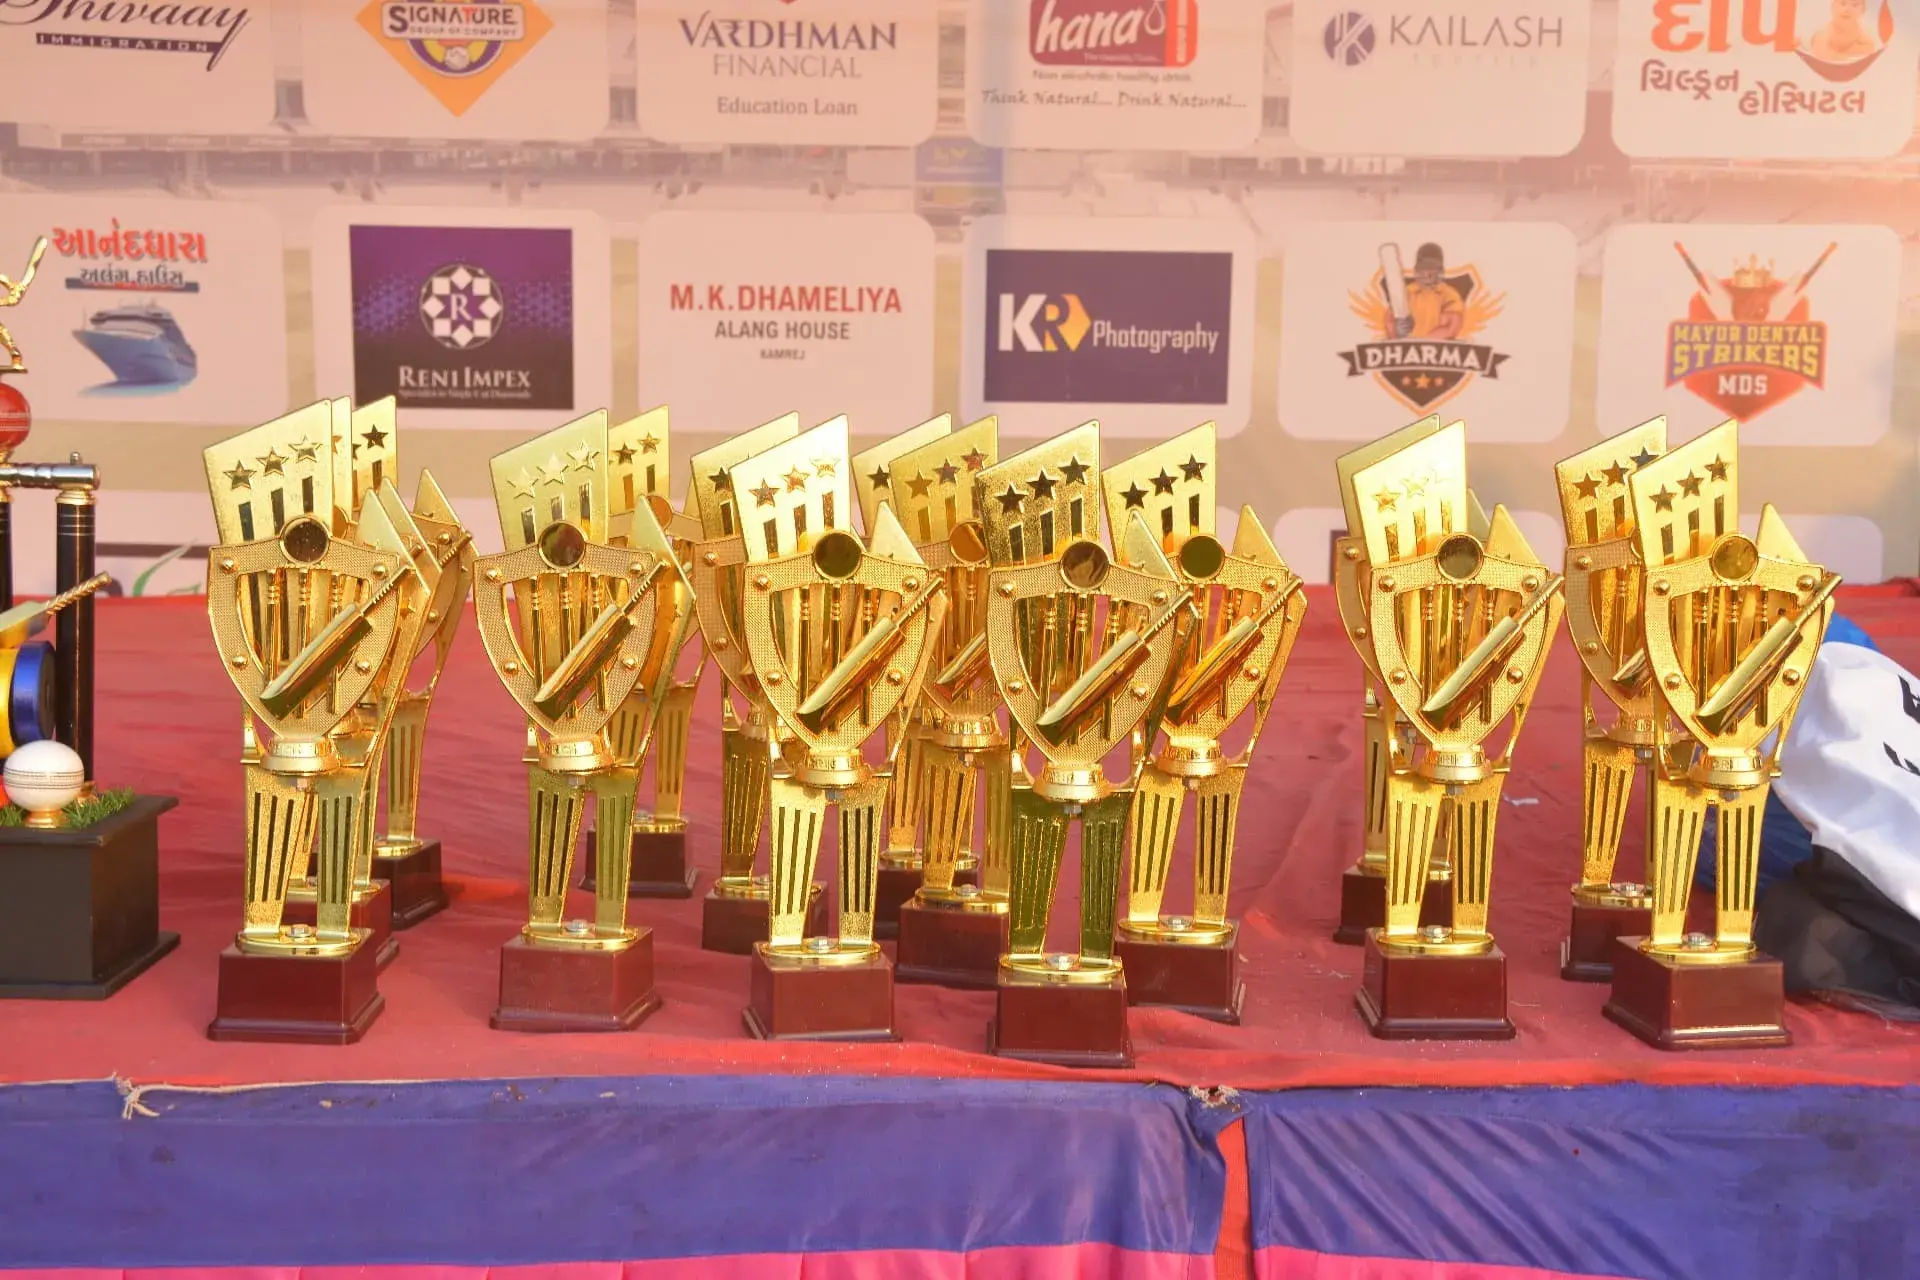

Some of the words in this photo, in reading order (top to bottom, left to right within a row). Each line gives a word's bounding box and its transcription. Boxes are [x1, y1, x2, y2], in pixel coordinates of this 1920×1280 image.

[389, 6, 518, 33] SIGNATURE
[678, 10, 896, 50] VARDHMAN
[1035, 0, 1144, 53] hana
[1390, 15, 1562, 48] KAILASH
[39, 34, 208, 52] IMMIGRATION
[713, 53, 862, 78] FINANCIAL
[1640, 59, 1739, 100] ચિલ્ડ્રન
[717, 96, 808, 114] Education
[814, 98, 858, 115] Loan
[982, 90, 1029, 105] Think
[1118, 91, 1163, 107] Drink
[1738, 81, 1865, 115] હોસ્પિટલ
[451, 293, 472, 320] R
[715, 320, 779, 339] ALANG
[786, 321, 851, 340] HOUSE
[1093, 320, 1219, 354] Photography
[1674, 325, 1741, 342] MAYUR
[1747, 326, 1821, 343] DENTAL
[760, 349, 805, 360] KAMREJ
[1365, 344, 1481, 370] DHARMA
[1672, 343, 1820, 378] STRIKERS
[1717, 373, 1768, 395] MDS
